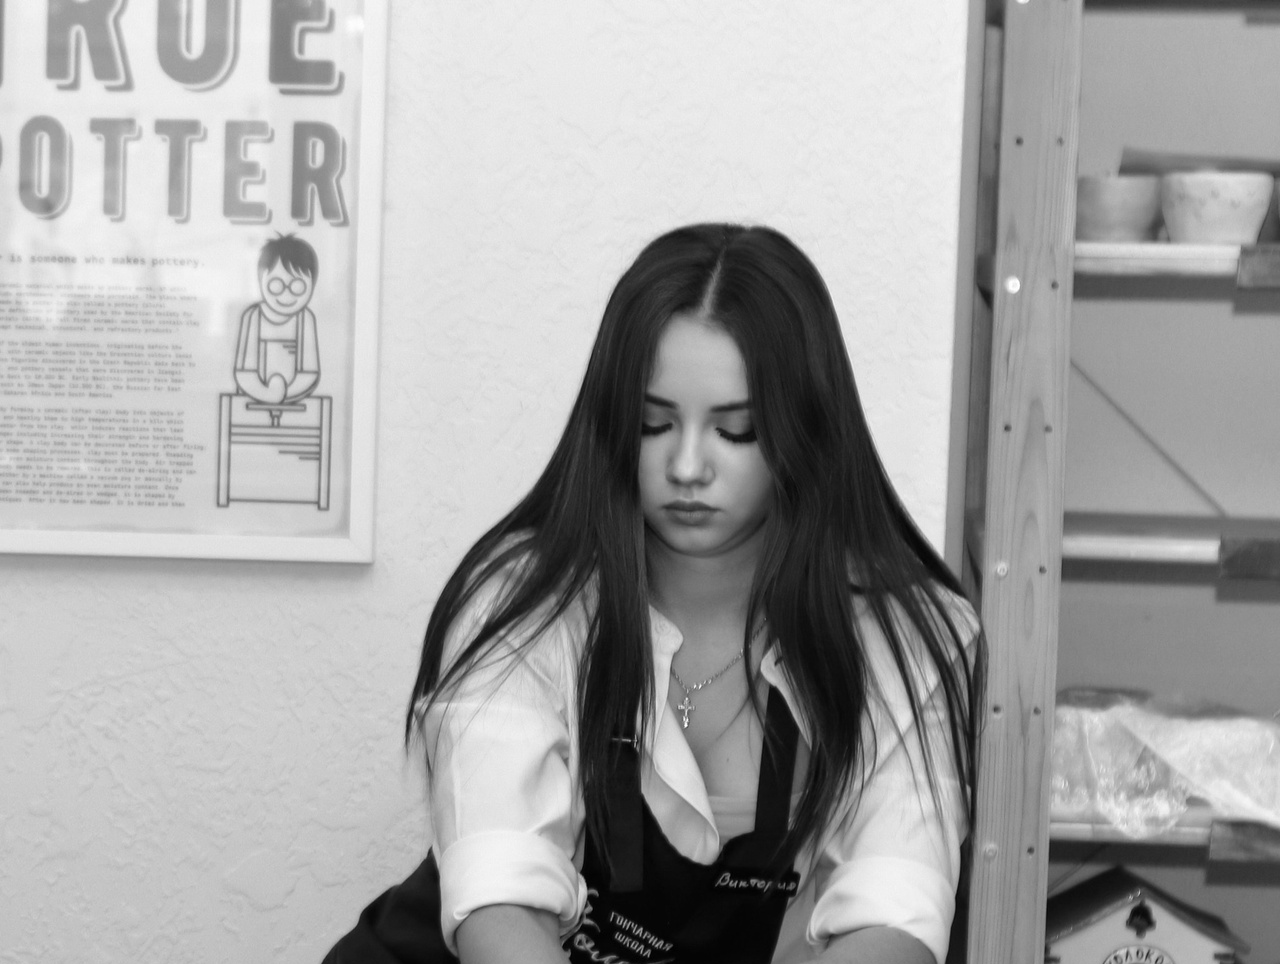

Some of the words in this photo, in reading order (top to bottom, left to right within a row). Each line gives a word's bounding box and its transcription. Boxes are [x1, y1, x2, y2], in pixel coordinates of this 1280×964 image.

[9, 253, 23, 263] is
[29, 254, 78, 264] someone
[84, 255, 105, 264] who
[111, 255, 146, 266] makes
[609, 911, 674, 952] ГОНЧАРНАЯ
[614, 931, 652, 959] ШКОЛА
